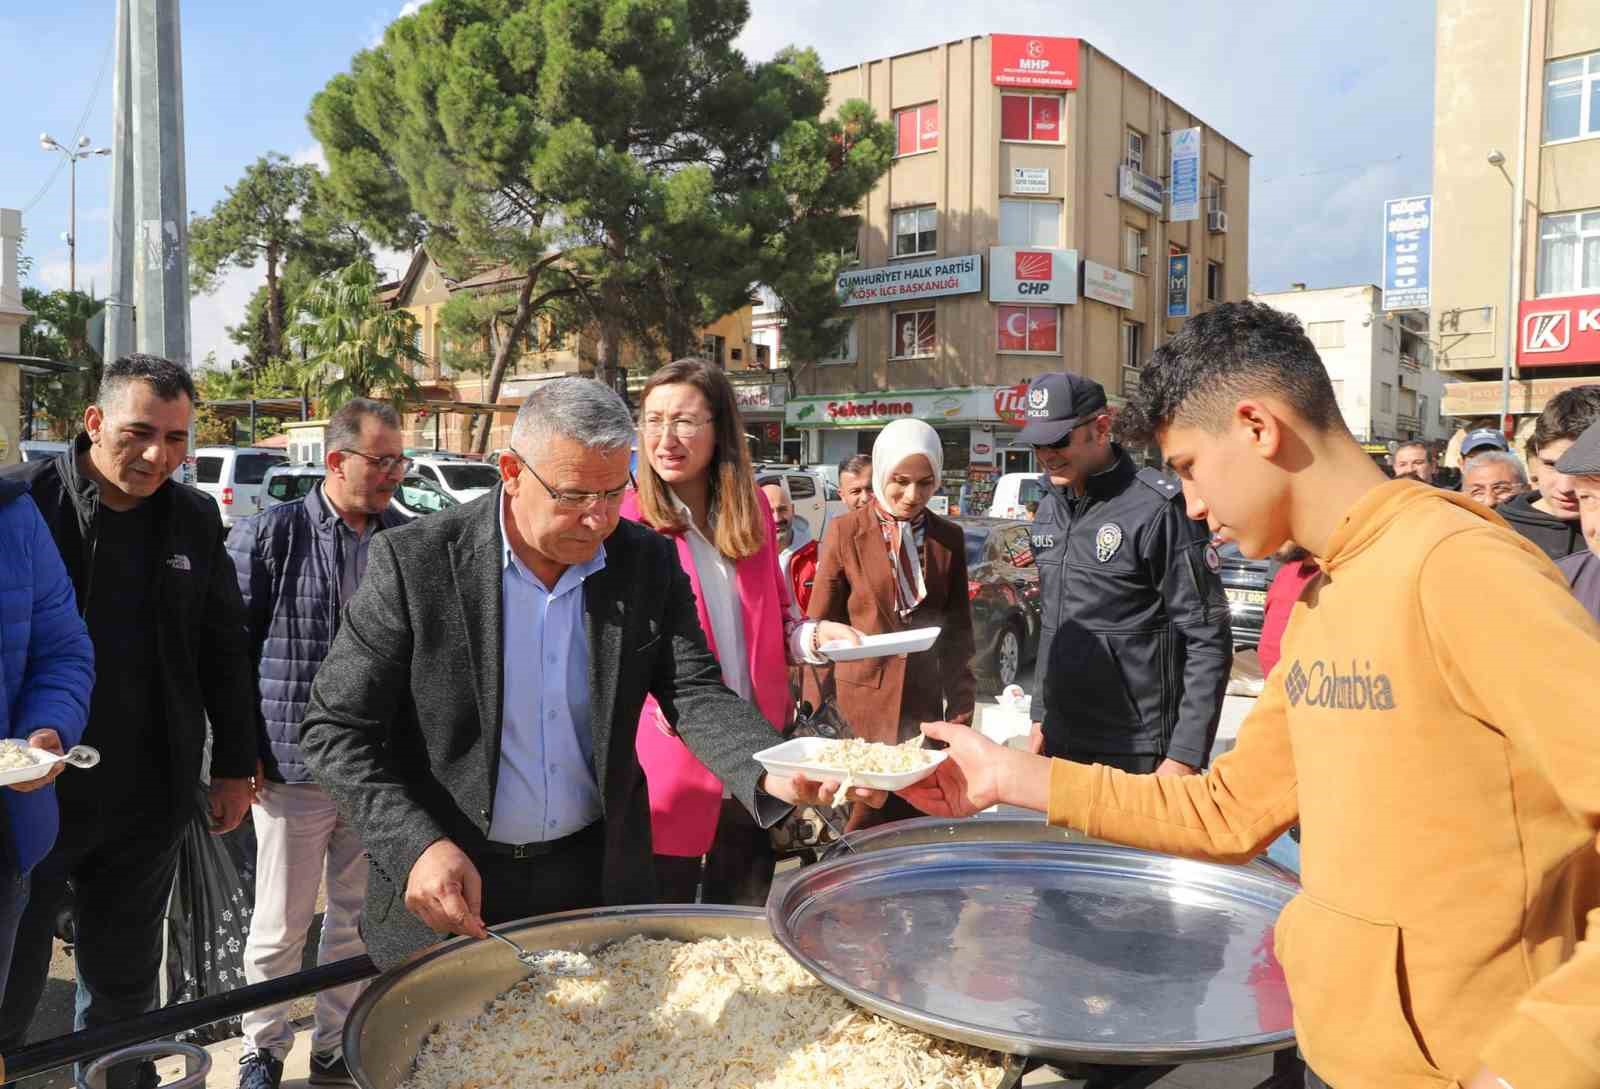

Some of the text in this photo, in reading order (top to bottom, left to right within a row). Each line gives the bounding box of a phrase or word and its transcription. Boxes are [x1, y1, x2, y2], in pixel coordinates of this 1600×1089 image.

[1019, 58, 1050, 69] MHP
[838, 259, 975, 289] CUMHURİYET HALK PARTİSİ
[900, 277, 960, 295] BAŞKANLIĞI
[1018, 282, 1050, 295] CHP
[1306, 659, 1397, 711] Columbia
